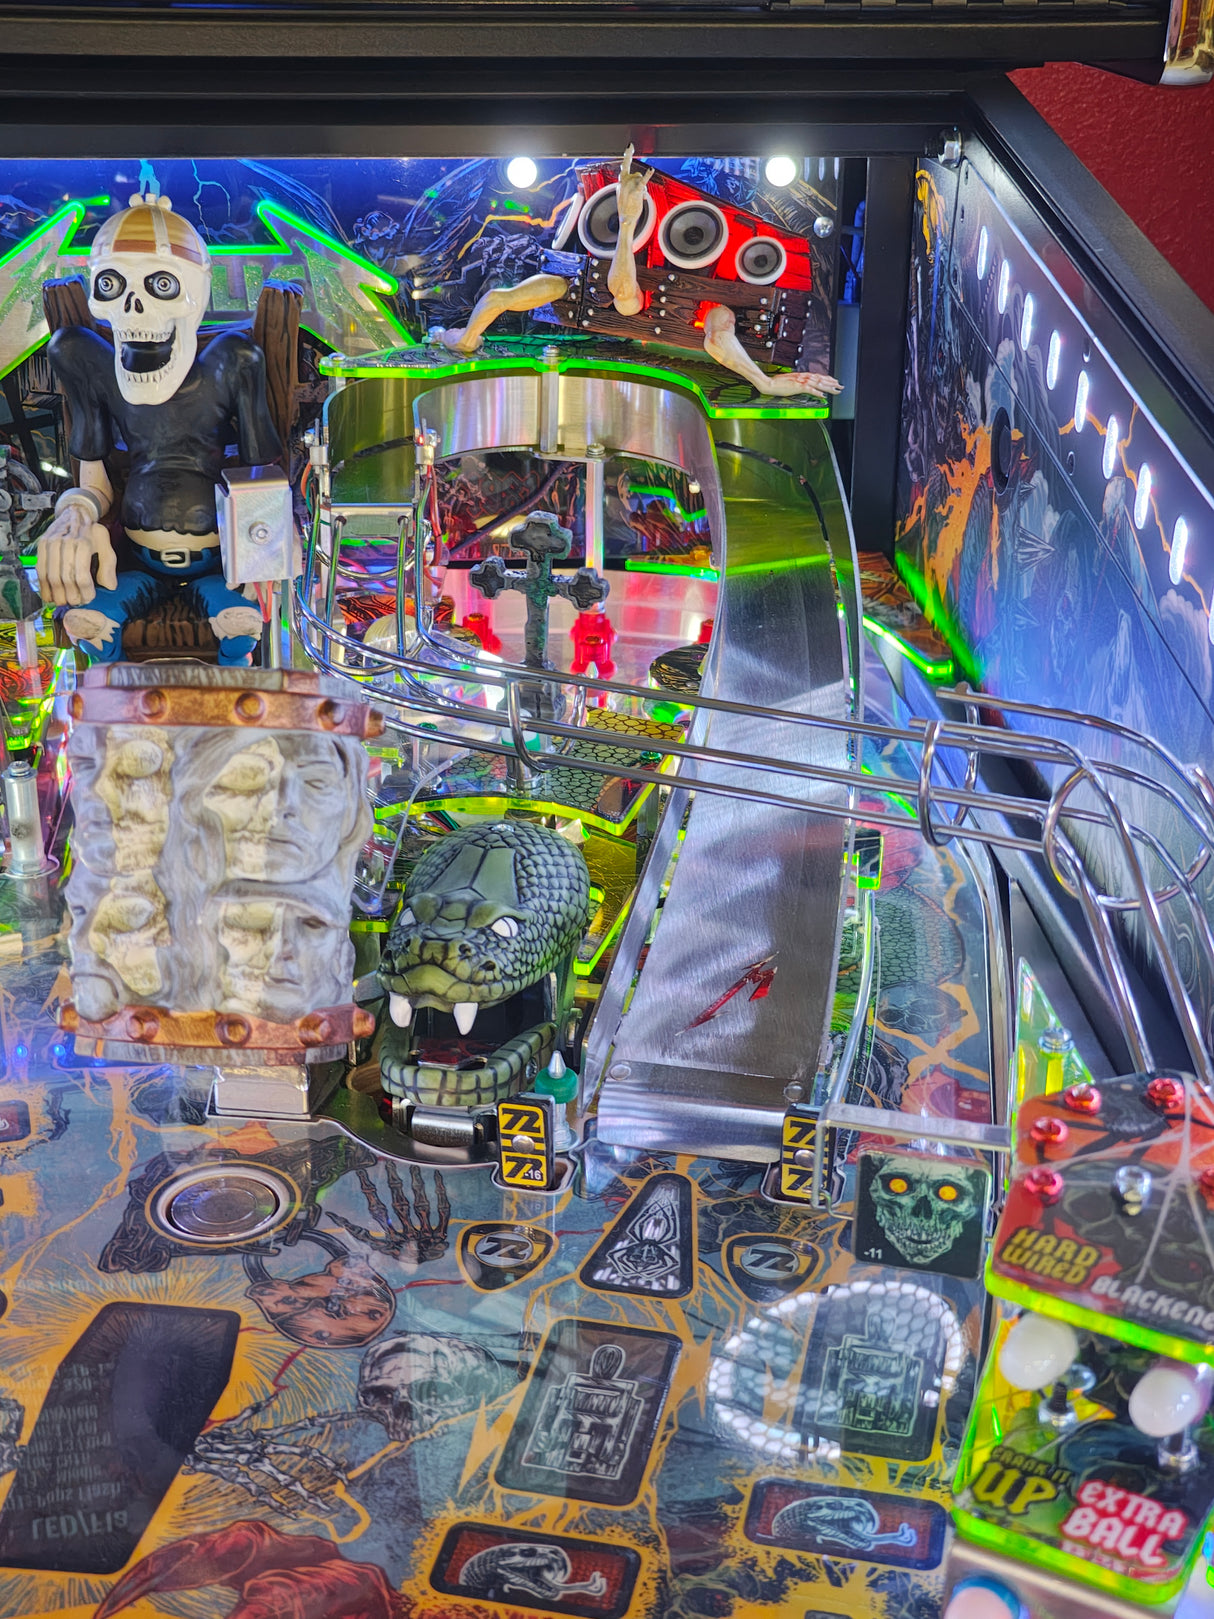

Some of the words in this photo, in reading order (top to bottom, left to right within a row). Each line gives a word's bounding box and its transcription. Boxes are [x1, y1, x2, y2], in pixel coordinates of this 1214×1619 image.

[863, 1247, 883, 1259] -11
[1001, 1244, 1088, 1285] WIRED
[1011, 1227, 1099, 1268] HARD
[972, 1462, 1057, 1514] UP
[1079, 1481, 1186, 1539] EXTRA
[1062, 1506, 1164, 1566] BALL
